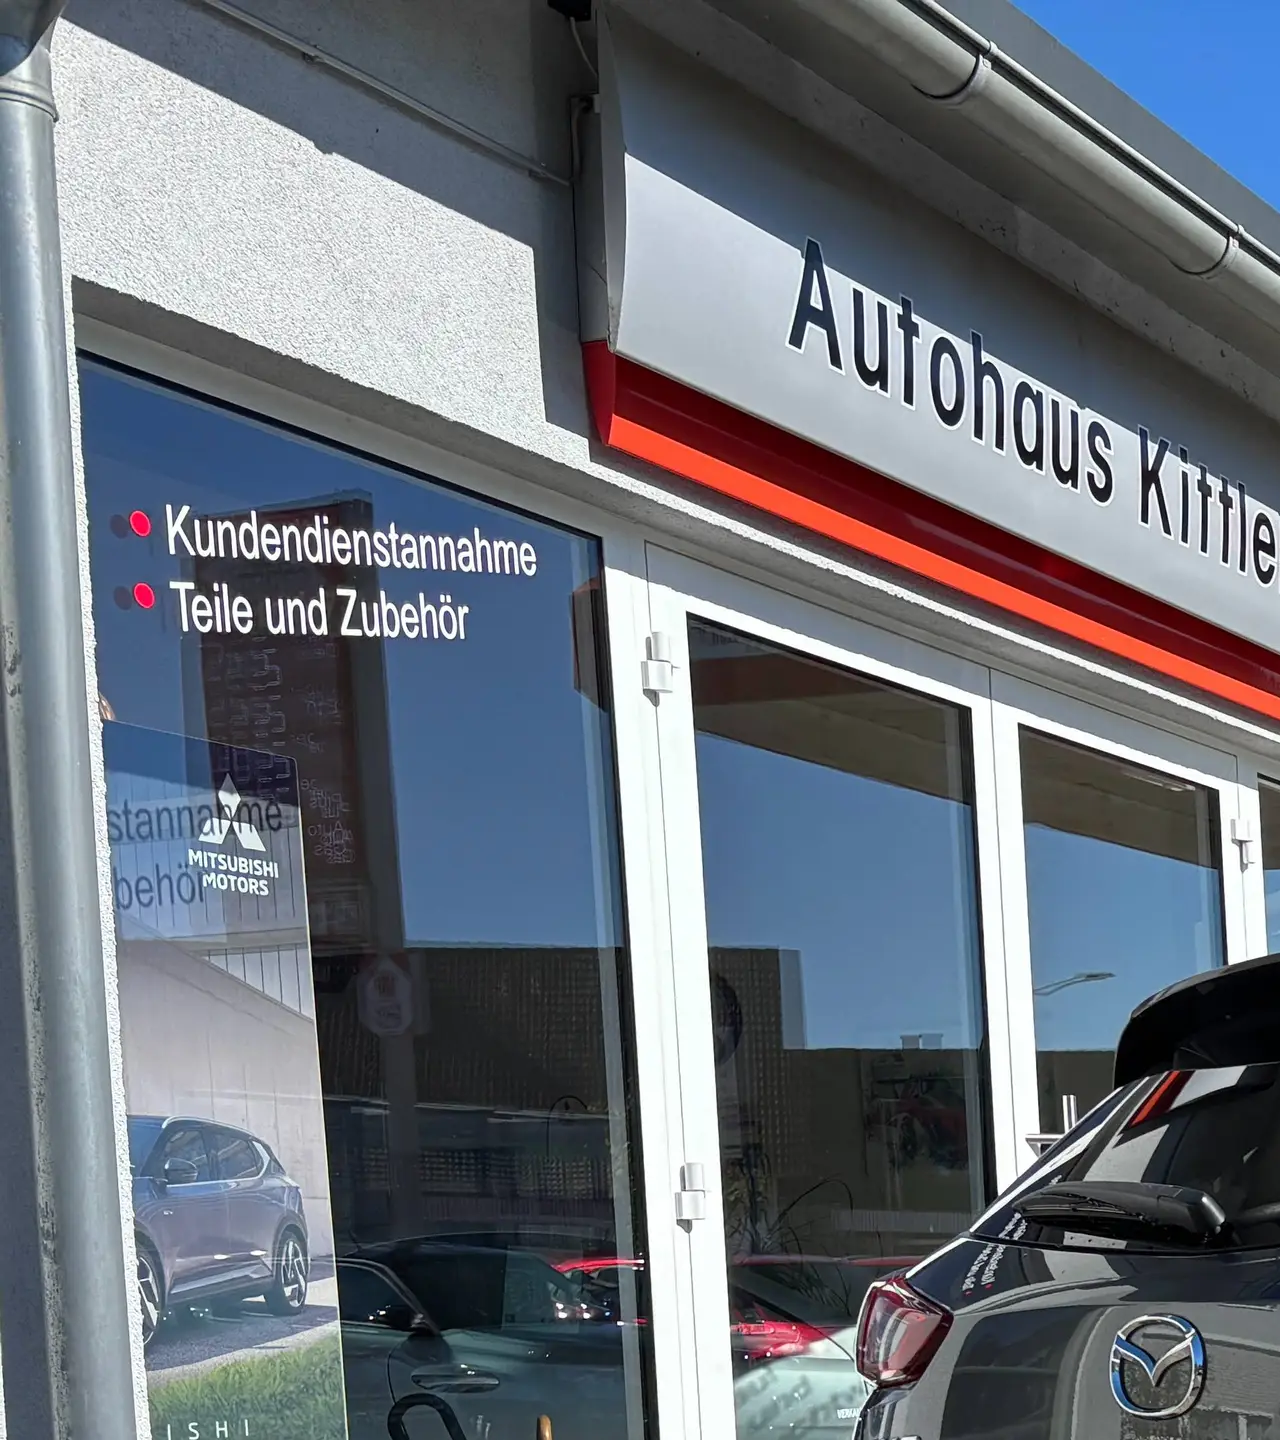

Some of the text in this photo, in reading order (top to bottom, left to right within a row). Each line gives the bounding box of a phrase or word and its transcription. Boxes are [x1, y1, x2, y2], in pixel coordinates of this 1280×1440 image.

[785, 236, 1116, 507] Autohaus
[165, 503, 537, 577] Kundendienstannahme
[169, 580, 253, 635] Teile
[266, 587, 328, 636] und
[336, 587, 469, 641] Zubehör
[188, 848, 279, 878] MITSUBISHI
[202, 872, 269, 896] MOTORS
